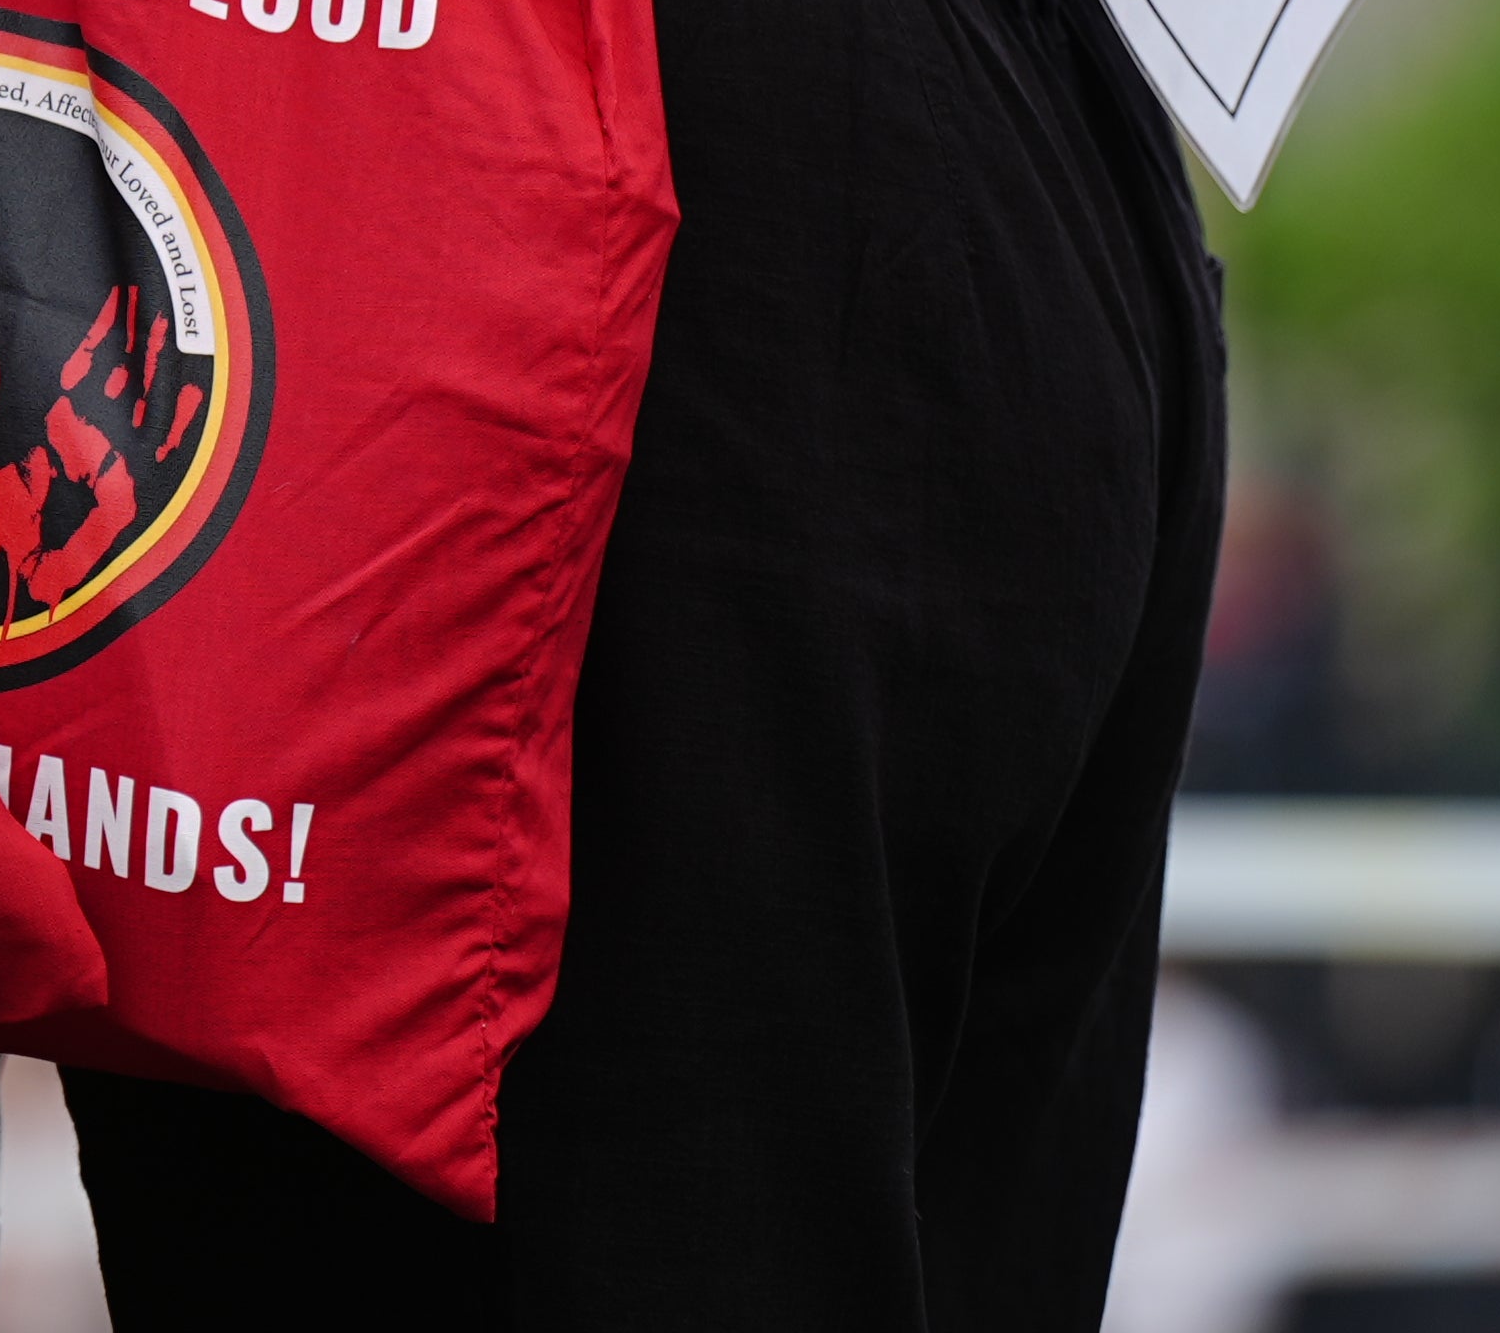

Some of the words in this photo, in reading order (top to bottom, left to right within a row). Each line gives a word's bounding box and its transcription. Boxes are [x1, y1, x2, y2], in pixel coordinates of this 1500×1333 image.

[117, 160, 174, 230] Loved
[161, 231, 193, 280] and
[178, 284, 200, 338] Lost
